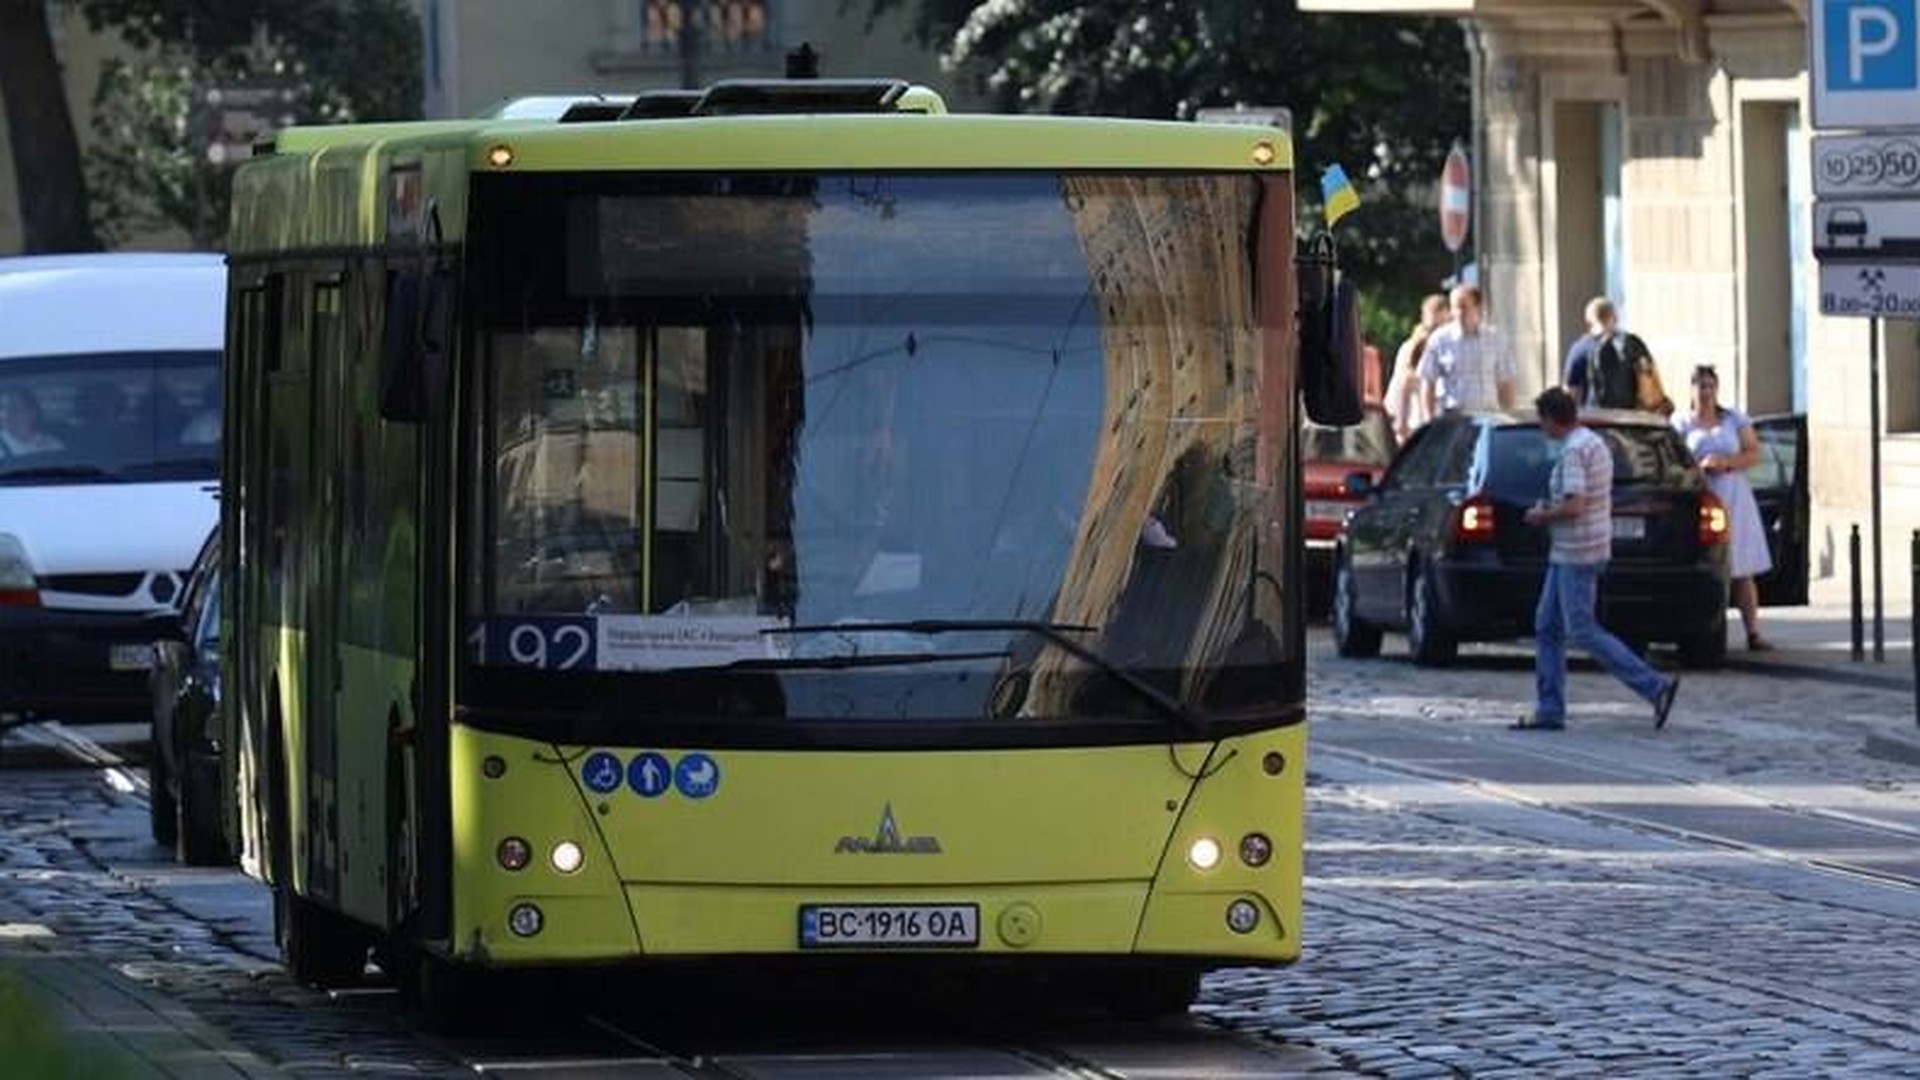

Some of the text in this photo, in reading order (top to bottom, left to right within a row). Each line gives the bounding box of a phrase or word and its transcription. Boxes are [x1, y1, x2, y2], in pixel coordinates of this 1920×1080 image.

[1849, 6, 1898, 83] P
[1826, 152, 1917, 176] 10 25 50
